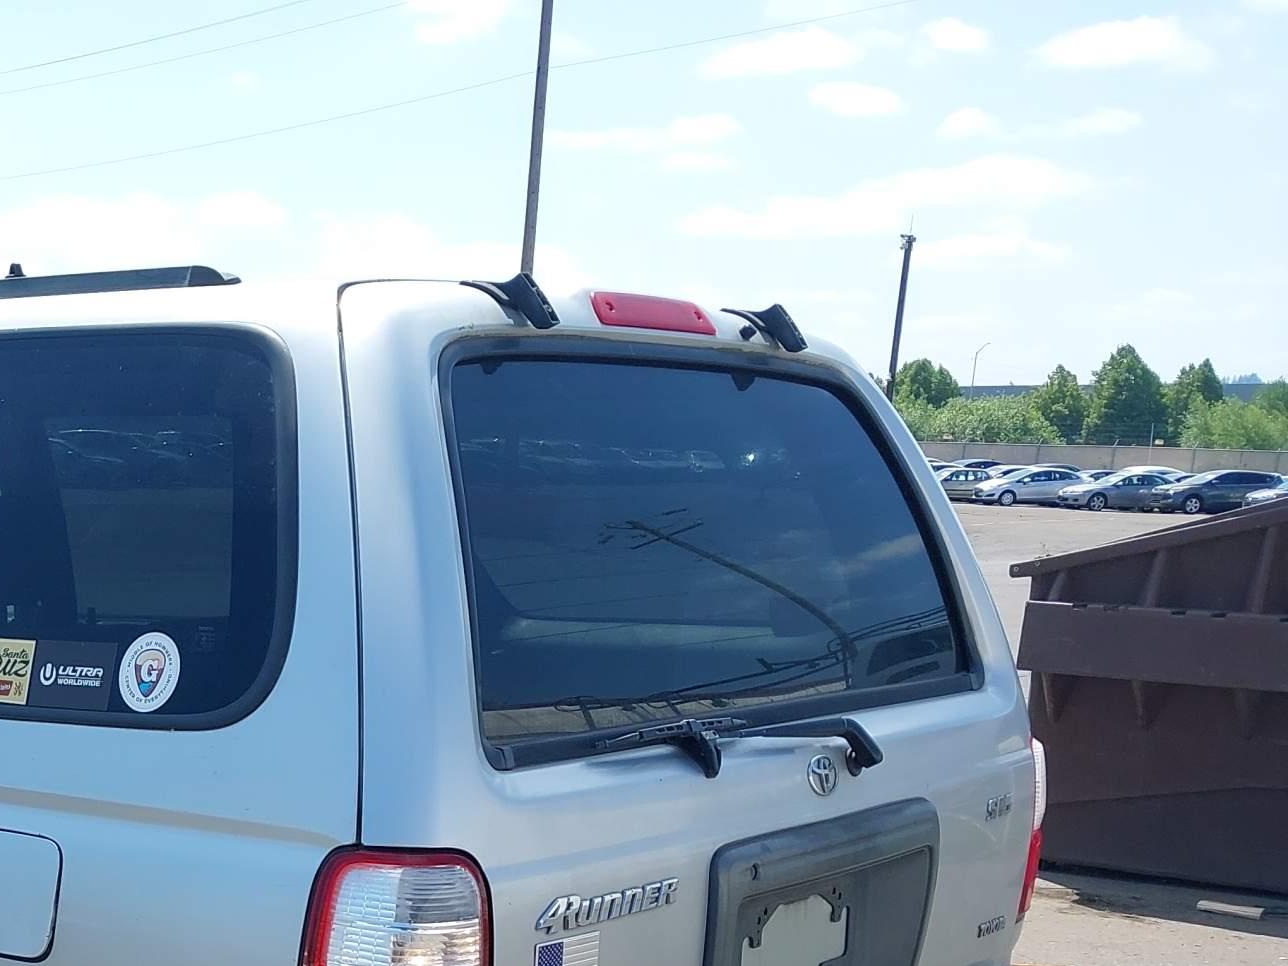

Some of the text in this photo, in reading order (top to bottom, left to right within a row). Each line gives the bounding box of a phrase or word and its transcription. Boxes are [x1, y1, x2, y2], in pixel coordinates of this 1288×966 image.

[2, 647, 30, 660] Santa
[58, 665, 104, 678] ULTRA
[140, 659, 159, 682] G
[57, 678, 101, 687] WORLDWIDE
